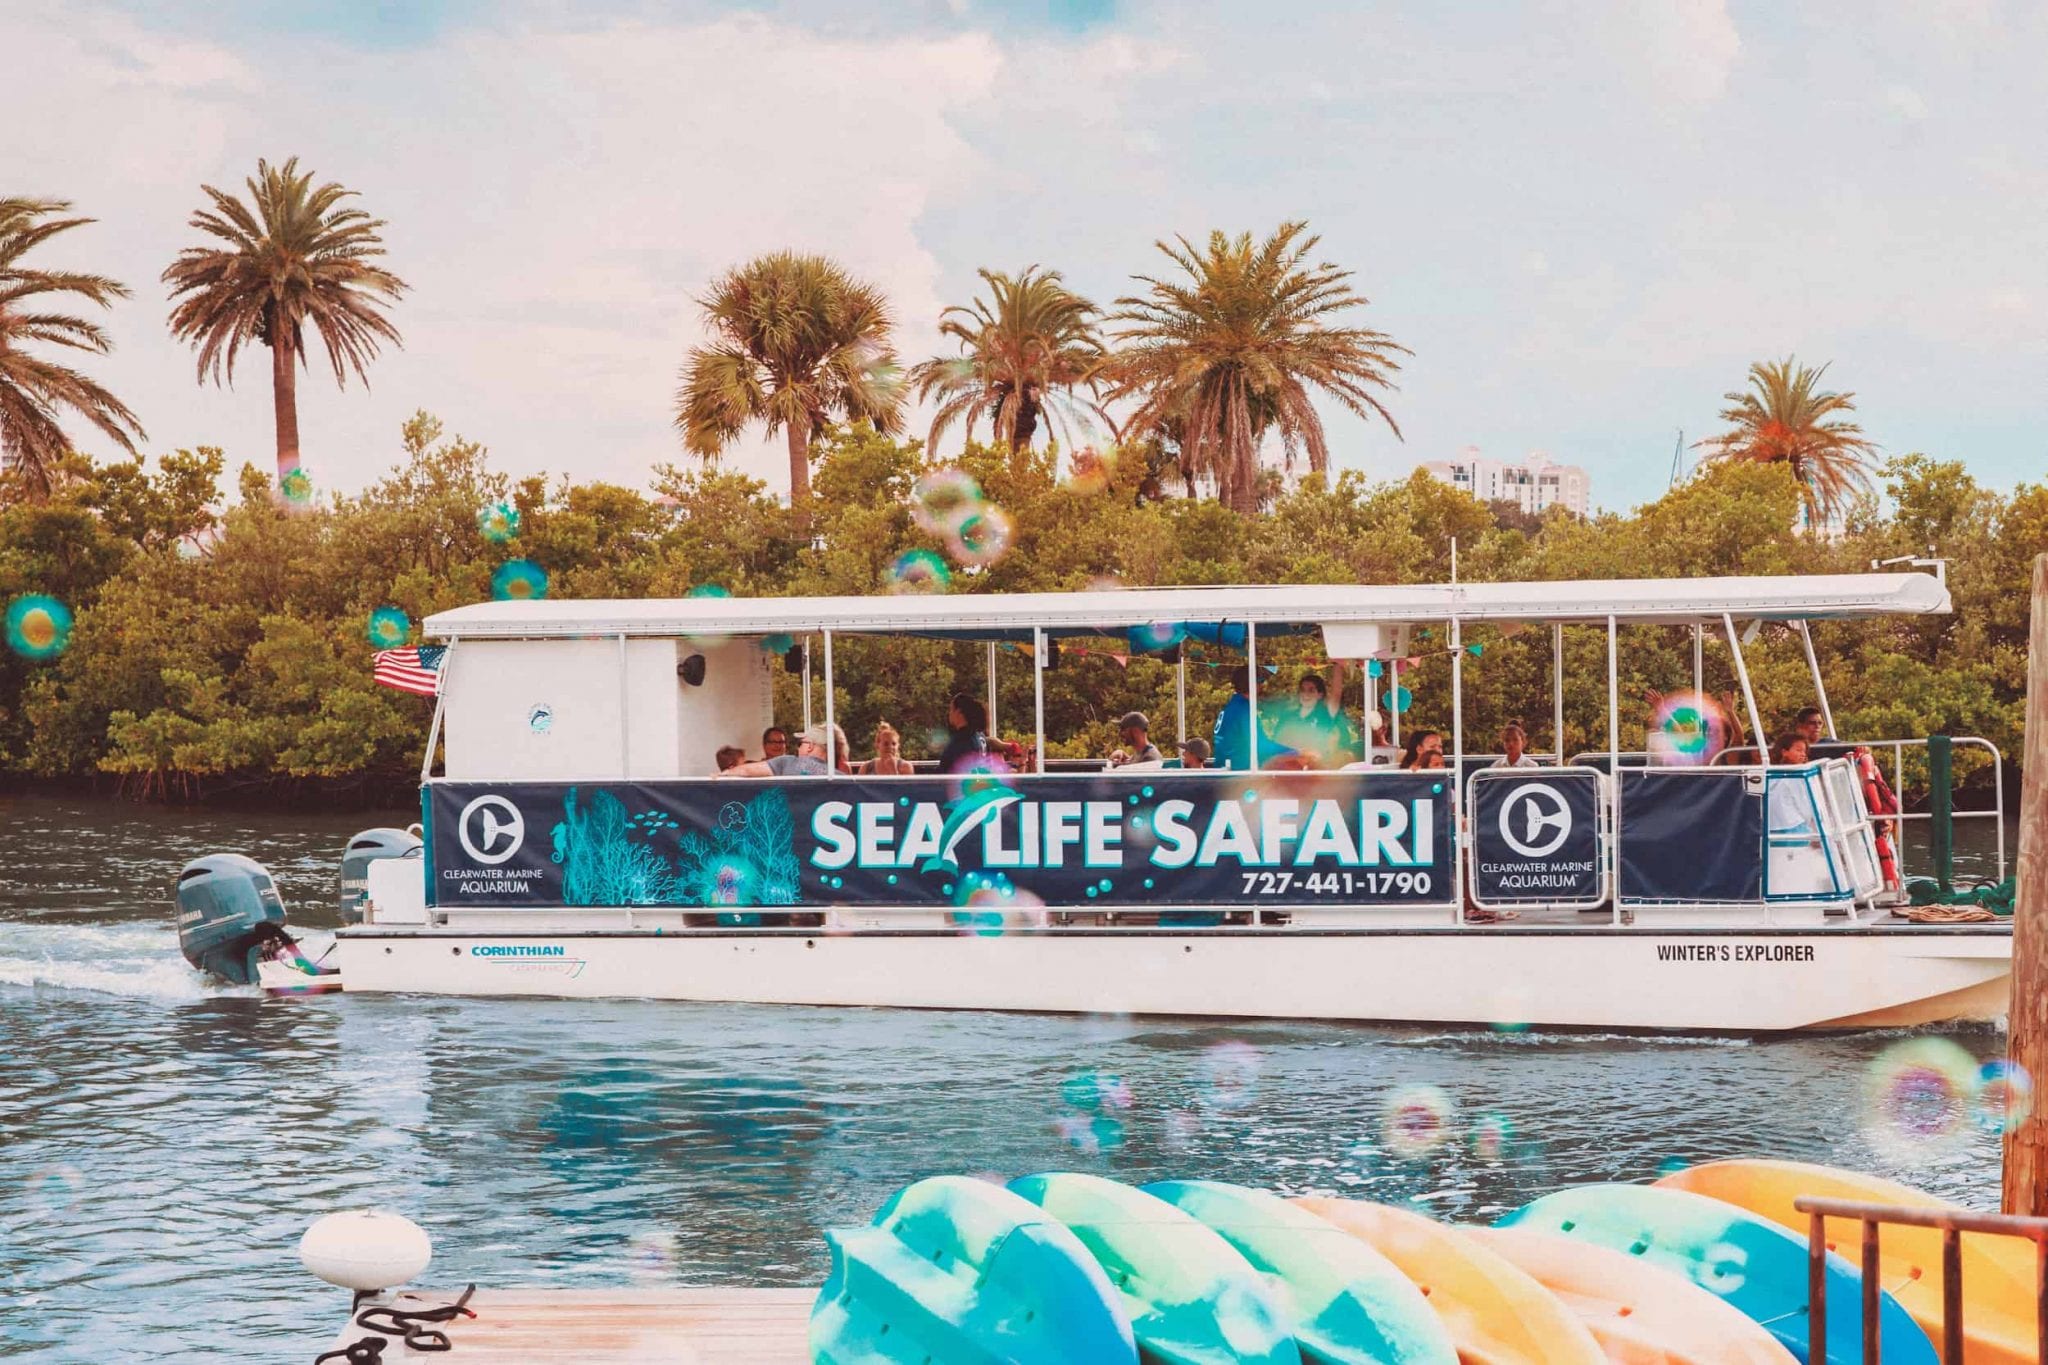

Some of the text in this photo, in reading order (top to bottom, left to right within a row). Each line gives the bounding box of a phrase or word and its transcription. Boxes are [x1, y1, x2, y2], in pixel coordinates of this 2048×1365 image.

[810, 798, 1434, 868] SEA LIFE SAFARI
[1481, 861, 1593, 873] CLEARWATER MARINE
[443, 869, 543, 879] CLEARWATER MARINE
[459, 881, 529, 893] AQUARIUM
[1242, 872, 1432, 894] 727-441-1790
[1499, 874, 1577, 888] AQUARIUM
[471, 946, 565, 956] CORINTHIAN
[1657, 945, 1815, 961] WINTER'S EXPLORER
